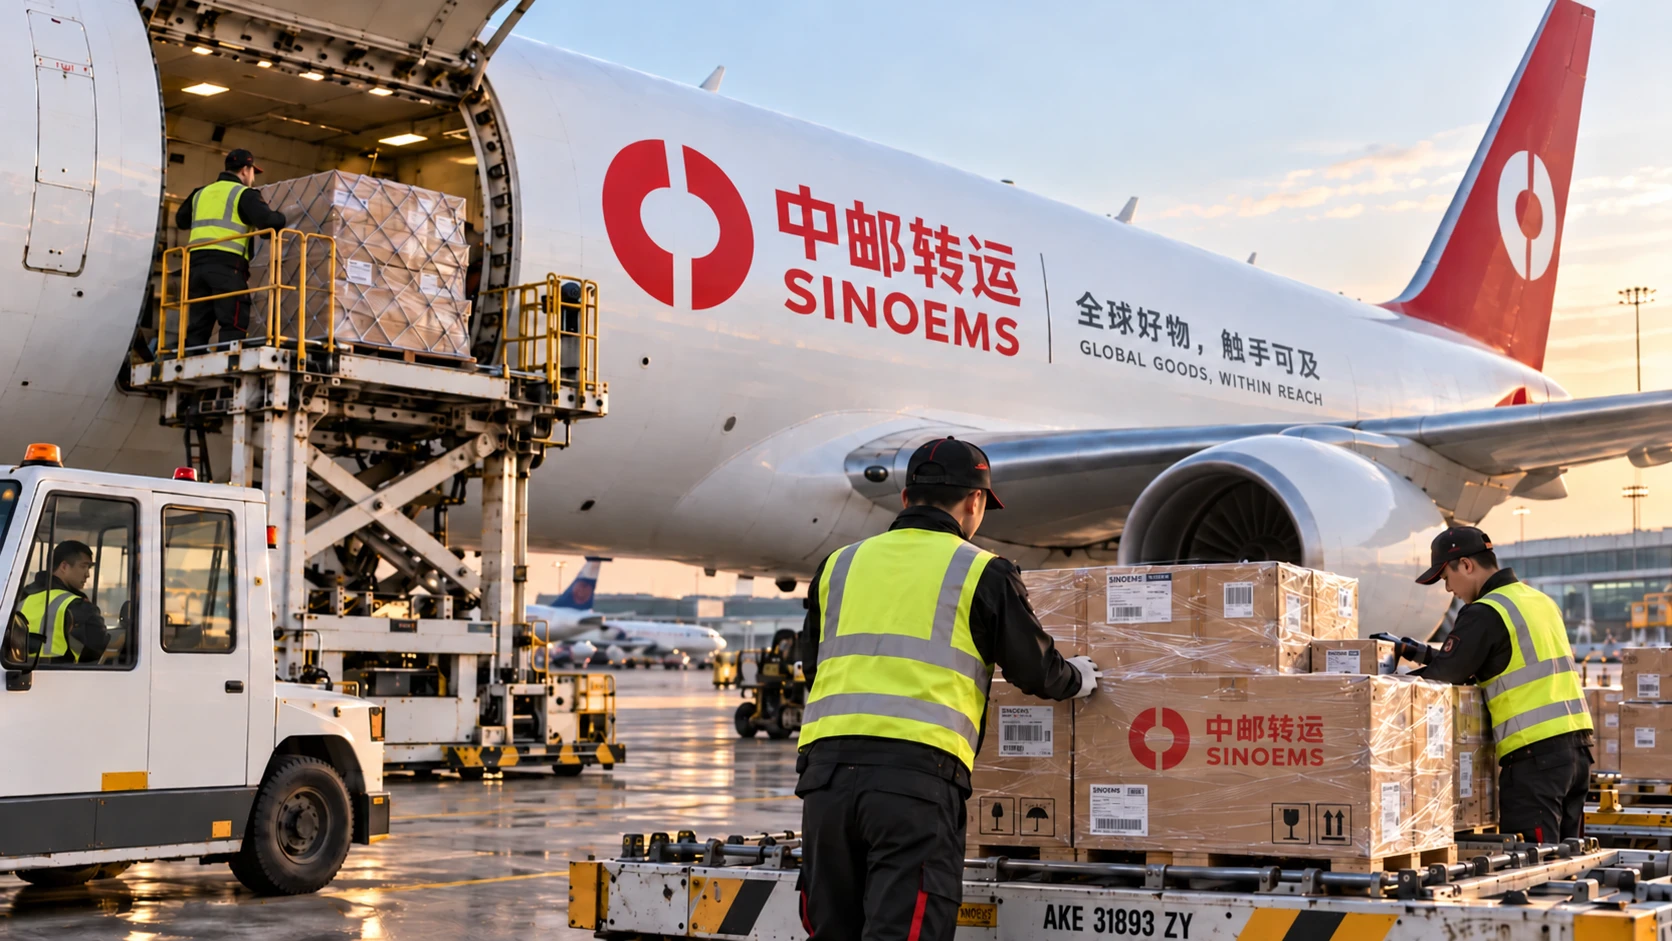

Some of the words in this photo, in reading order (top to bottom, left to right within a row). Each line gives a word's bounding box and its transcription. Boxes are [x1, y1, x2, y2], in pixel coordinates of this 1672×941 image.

[776, 184, 1021, 307] 中邮转运
[784, 268, 1020, 357] SINOEMS
[1079, 339, 1147, 368] GLOBAL
[1153, 356, 1213, 385] GOODS,
[1219, 370, 1272, 396] WITHIN
[1278, 384, 1323, 407] REACH
[1206, 714, 1324, 743] 中邮转运
[1206, 747, 1324, 767] SINOEMS
[1043, 904, 1084, 931] AKE
[1093, 907, 1155, 936] 31893
[1164, 911, 1193, 939] ZY
